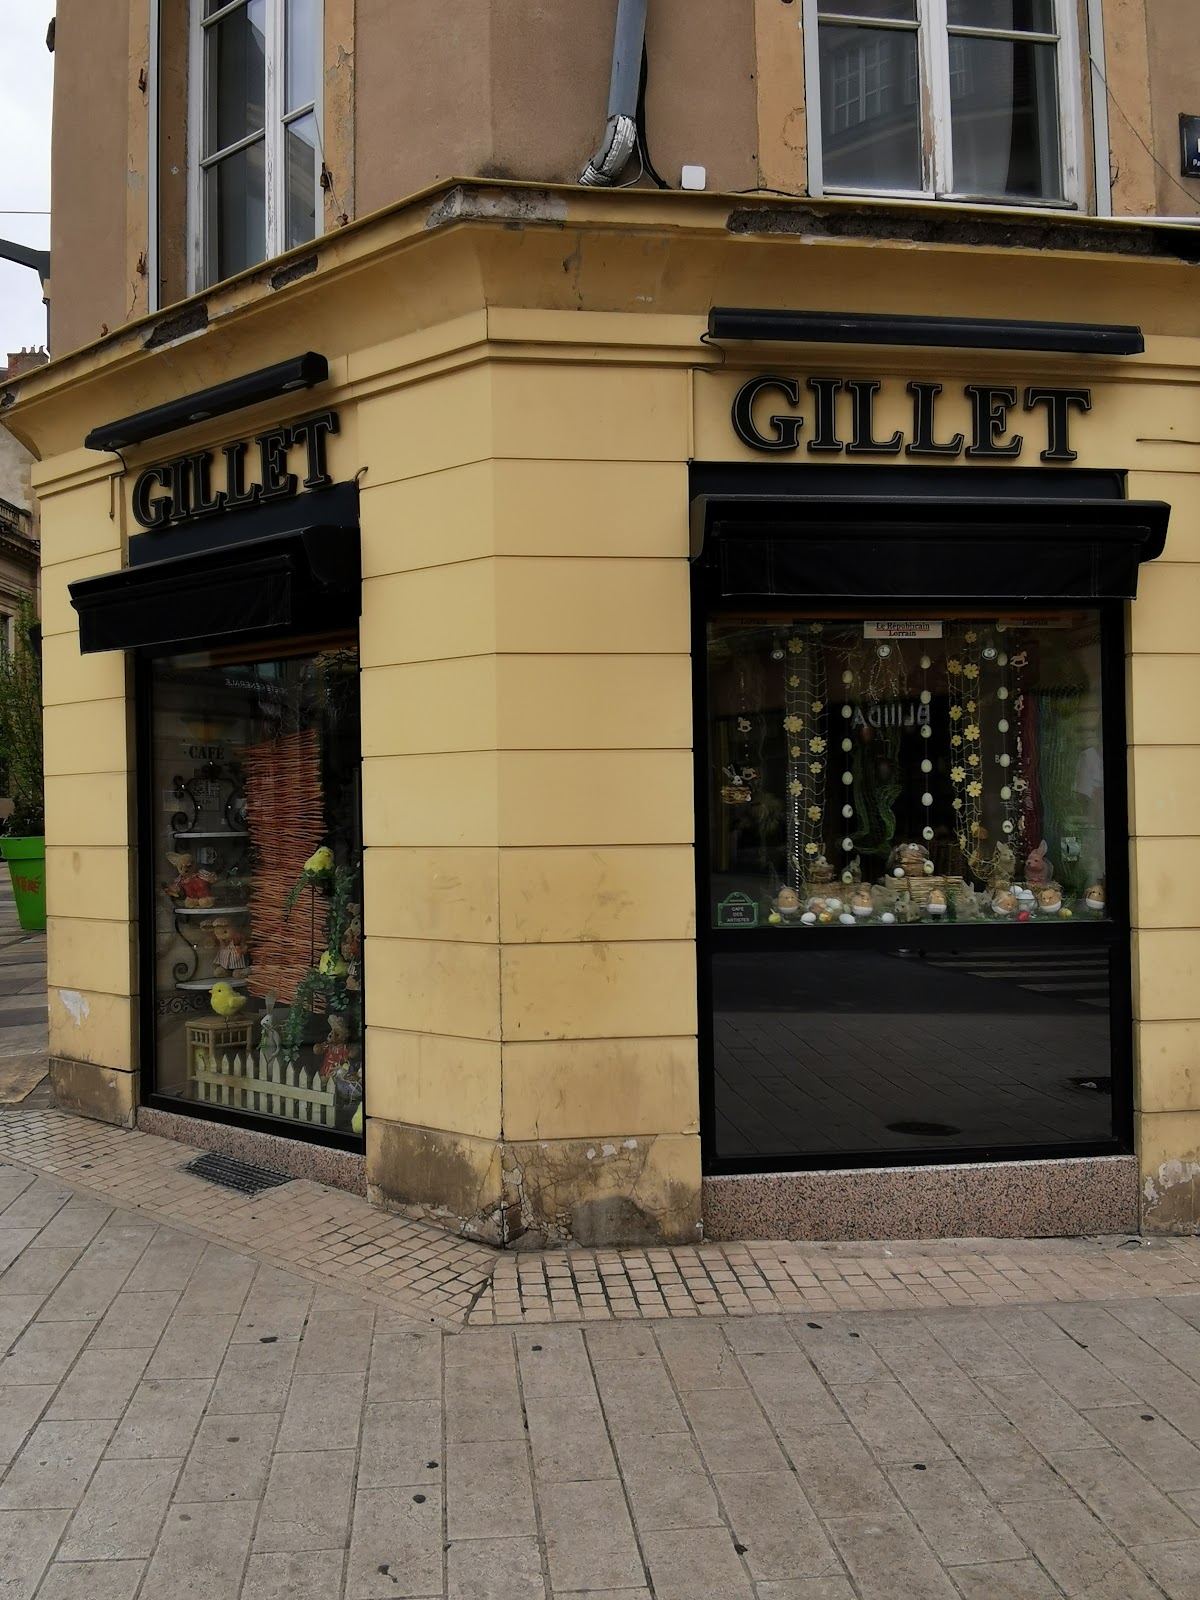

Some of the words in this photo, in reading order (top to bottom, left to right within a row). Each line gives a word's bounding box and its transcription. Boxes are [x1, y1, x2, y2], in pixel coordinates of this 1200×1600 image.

[731, 375, 1092, 462] GILLET
[131, 410, 340, 529] GILLET
[876, 622, 886, 630] Le
[887, 622, 930, 631] Républicain
